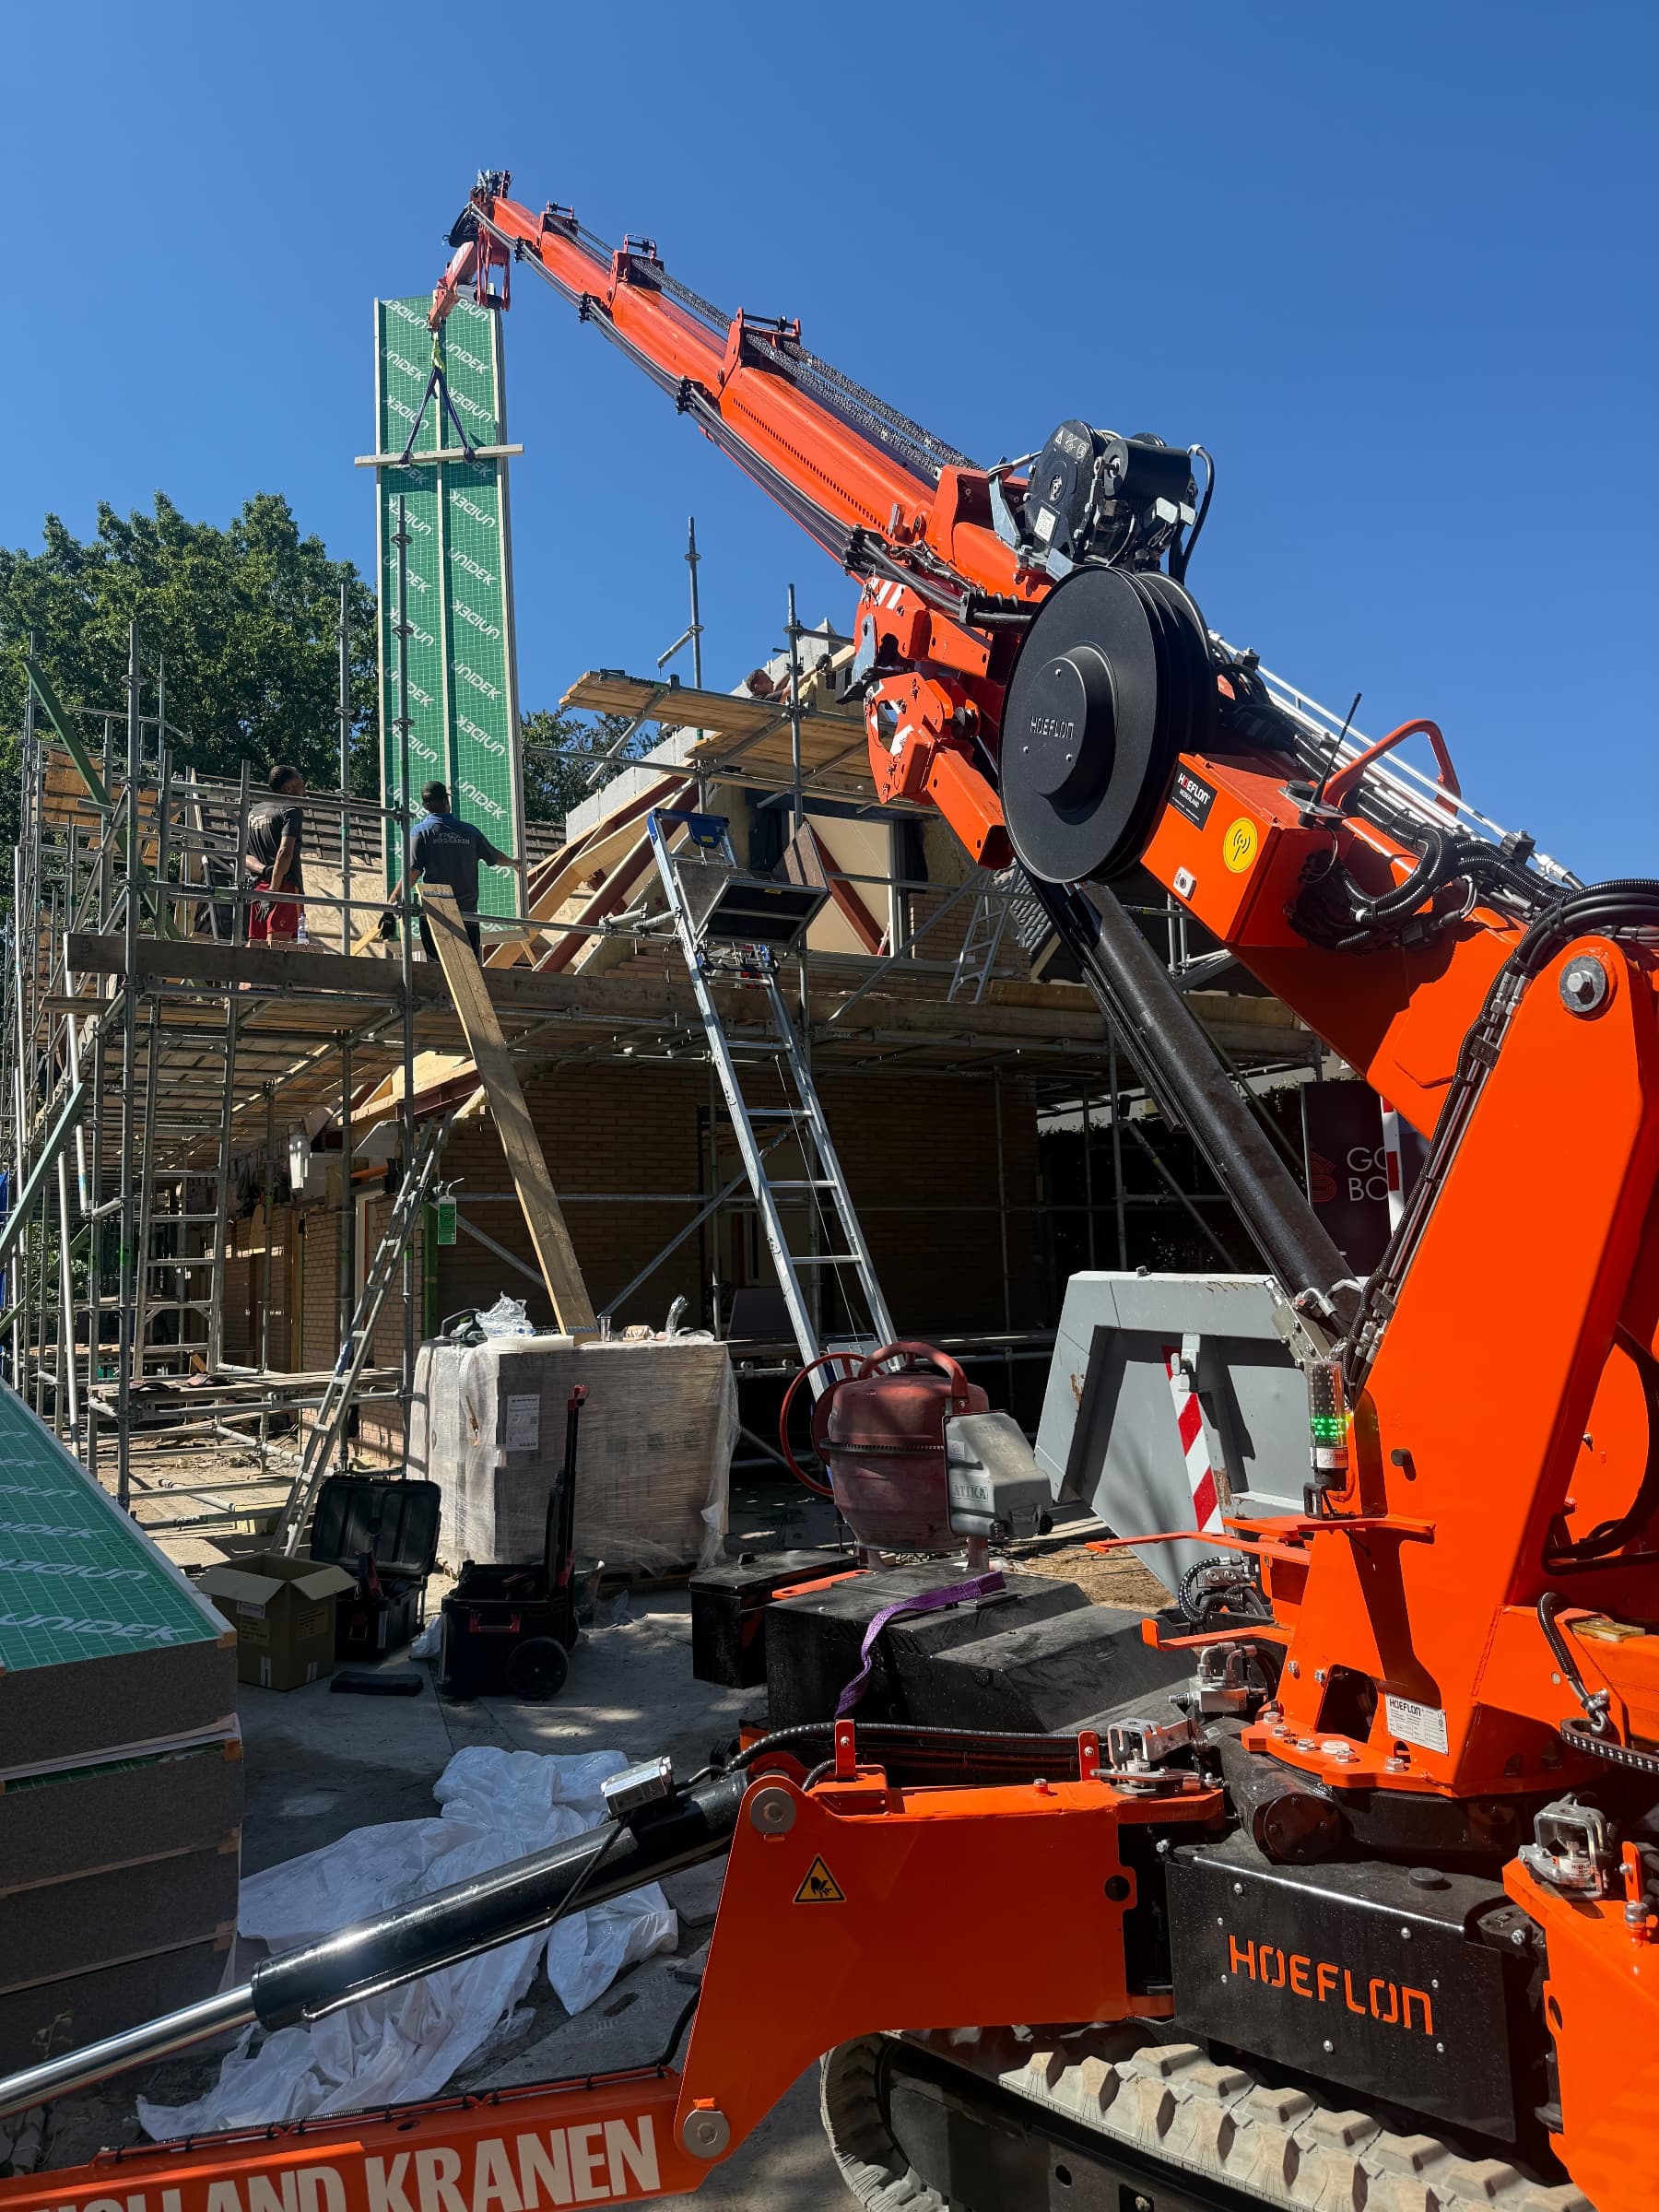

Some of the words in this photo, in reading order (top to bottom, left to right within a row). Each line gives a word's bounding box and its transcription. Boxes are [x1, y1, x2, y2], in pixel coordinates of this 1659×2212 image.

[457, 299, 488, 322] UNID
[381, 347, 428, 382] UNIDEK
[442, 340, 489, 375] UNIDEK
[447, 386, 492, 422] UNIDEK
[446, 489, 496, 528] UNIDEK
[382, 555, 432, 594] UDEK
[447, 547, 498, 587] UNIDEK
[450, 598, 500, 640] UNIDEK
[384, 666, 436, 708] UDEK
[451, 659, 502, 701] UNIDEK
[454, 713, 506, 757] UNIDEK
[1030, 715, 1075, 740] HOEFLON
[455, 776, 509, 820] UNIDEK
[0, 1521, 111, 1538] IDEK
[0, 1613, 195, 1641] UNIDEK
[1389, 1698, 1421, 1717] HOEFLON
[1228, 1935, 1433, 2035] HOEFLON
[364, 2114, 661, 2212] KRANEN
